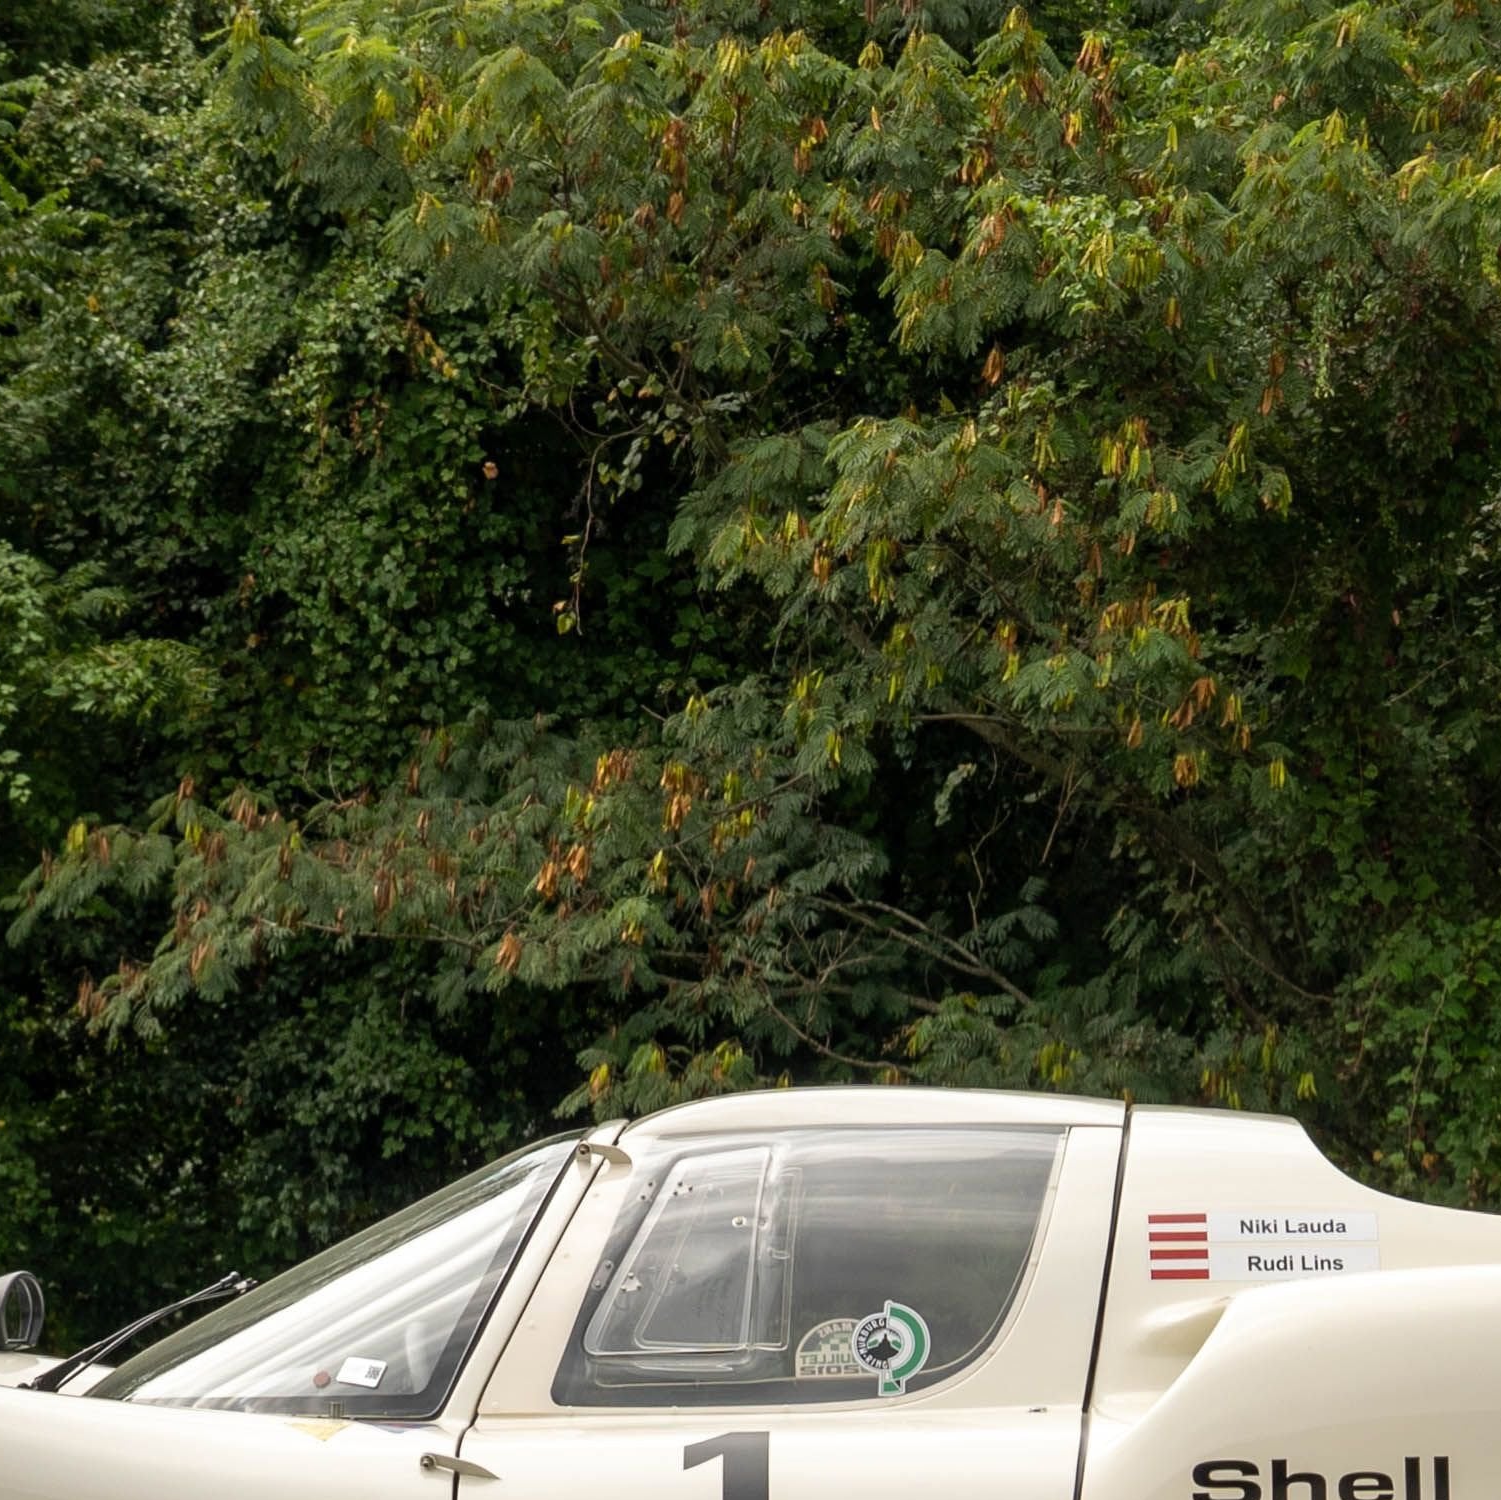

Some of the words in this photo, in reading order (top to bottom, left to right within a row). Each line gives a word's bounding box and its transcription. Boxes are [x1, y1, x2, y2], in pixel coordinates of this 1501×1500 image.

[1240, 1219, 1278, 1234] Niki
[1285, 1219, 1346, 1234] Lauda
[1247, 1255, 1294, 1272] Rudi
[1301, 1255, 1344, 1271] Lins
